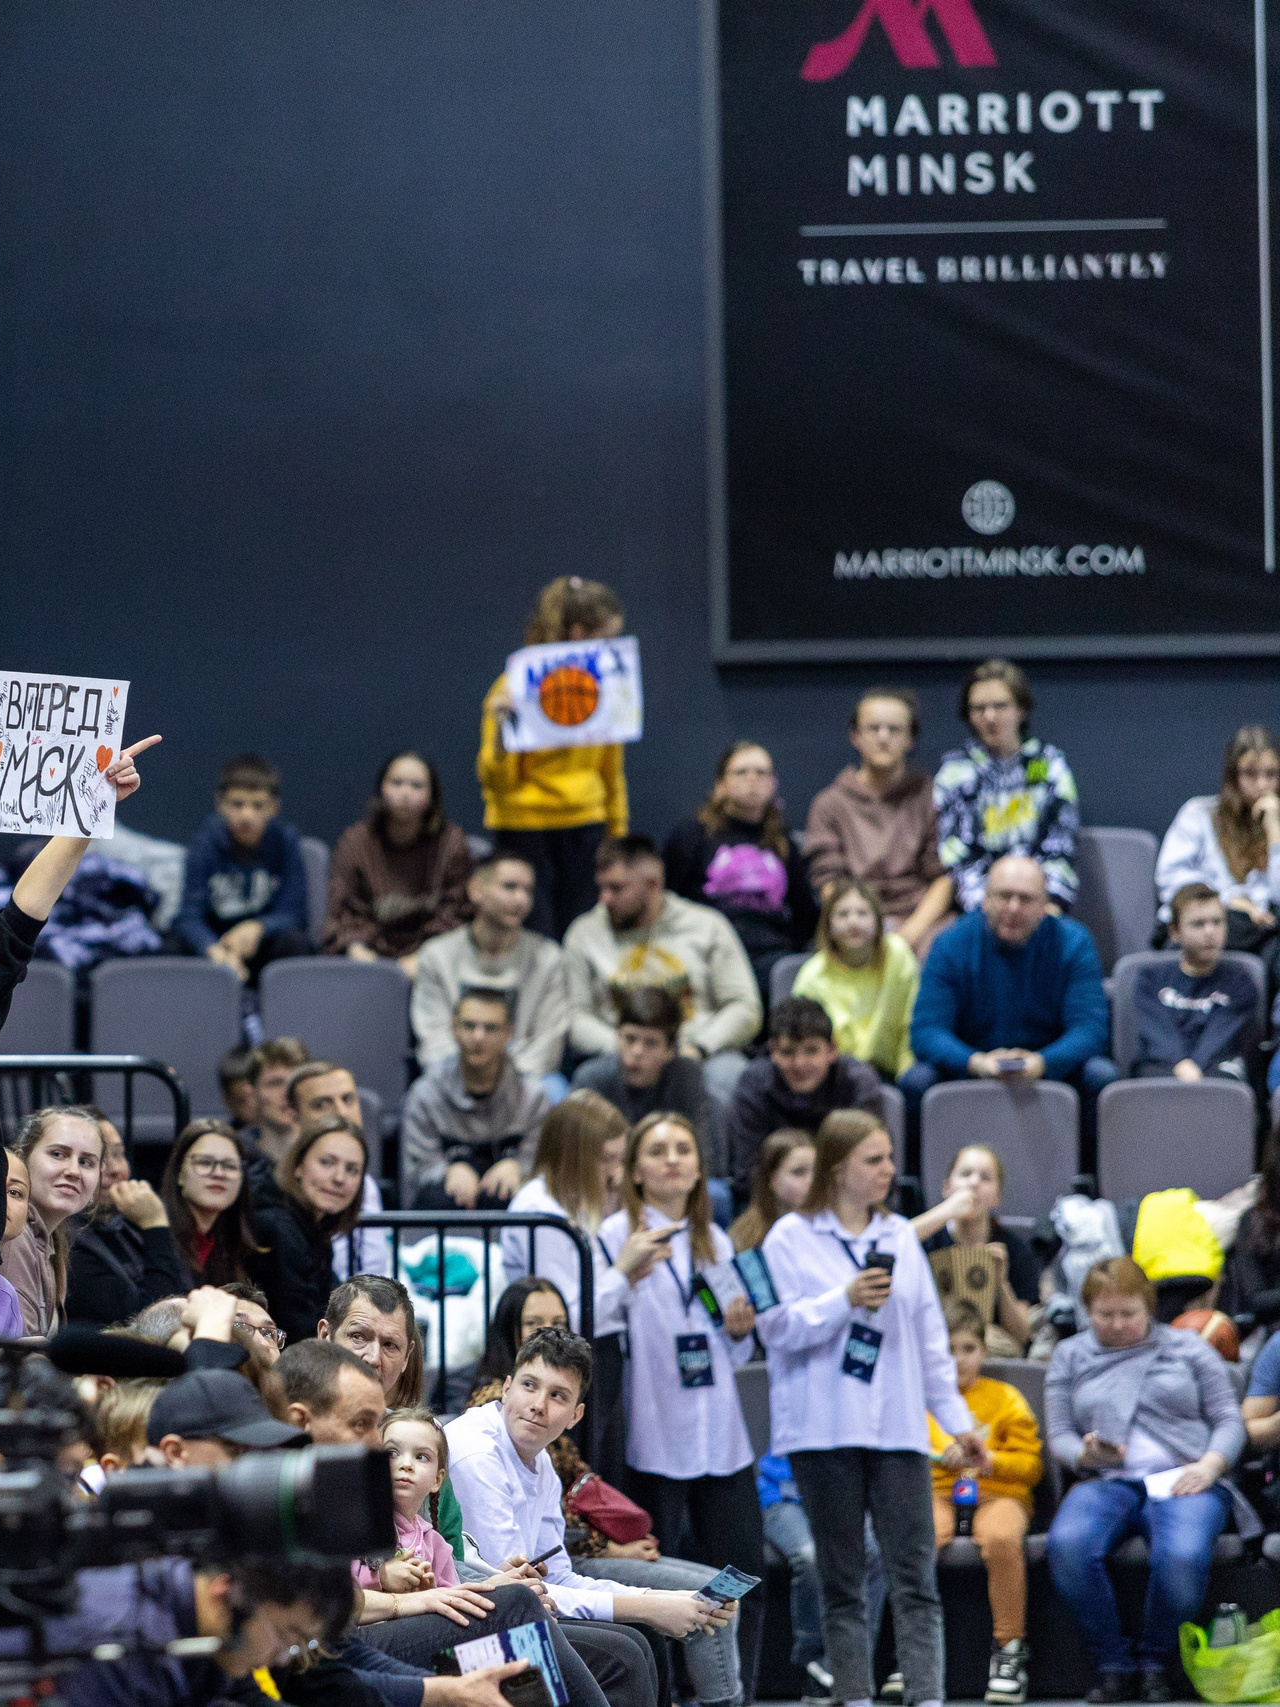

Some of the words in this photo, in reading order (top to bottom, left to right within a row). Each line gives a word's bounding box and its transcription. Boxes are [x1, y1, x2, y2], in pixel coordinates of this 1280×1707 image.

[846, 89, 1165, 138] MARRIOTT
[847, 150, 1038, 198] MINSK
[798, 256, 926, 286] TRAVEL
[936, 252, 1169, 284] BRILLIANTLY
[832, 543, 1148, 581] MARRIOTTMINSK.COM
[5, 680, 103, 739] ВПЕРЕД
